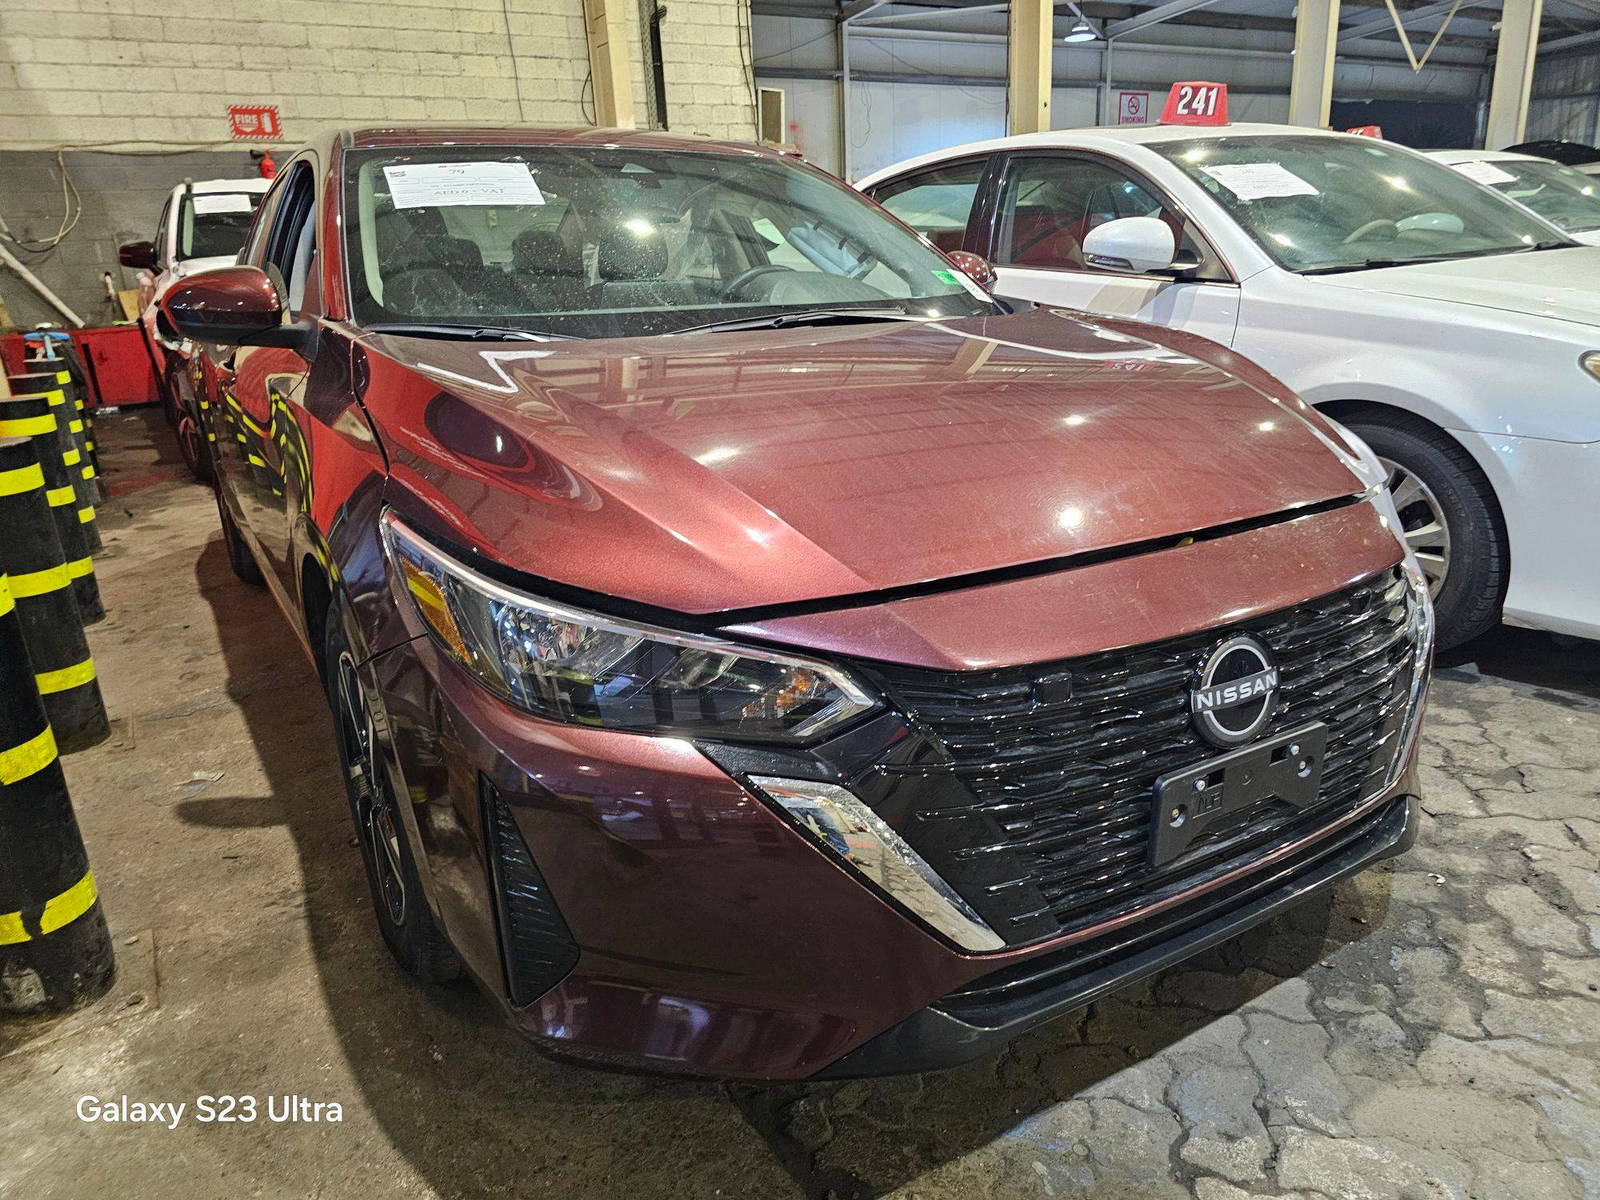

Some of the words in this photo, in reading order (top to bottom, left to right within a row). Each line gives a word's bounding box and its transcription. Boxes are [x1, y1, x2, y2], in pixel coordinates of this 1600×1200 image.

[1177, 86, 1218, 115] 241
[234, 114, 259, 124] FIRE
[1196, 670, 1277, 709] NISSAN
